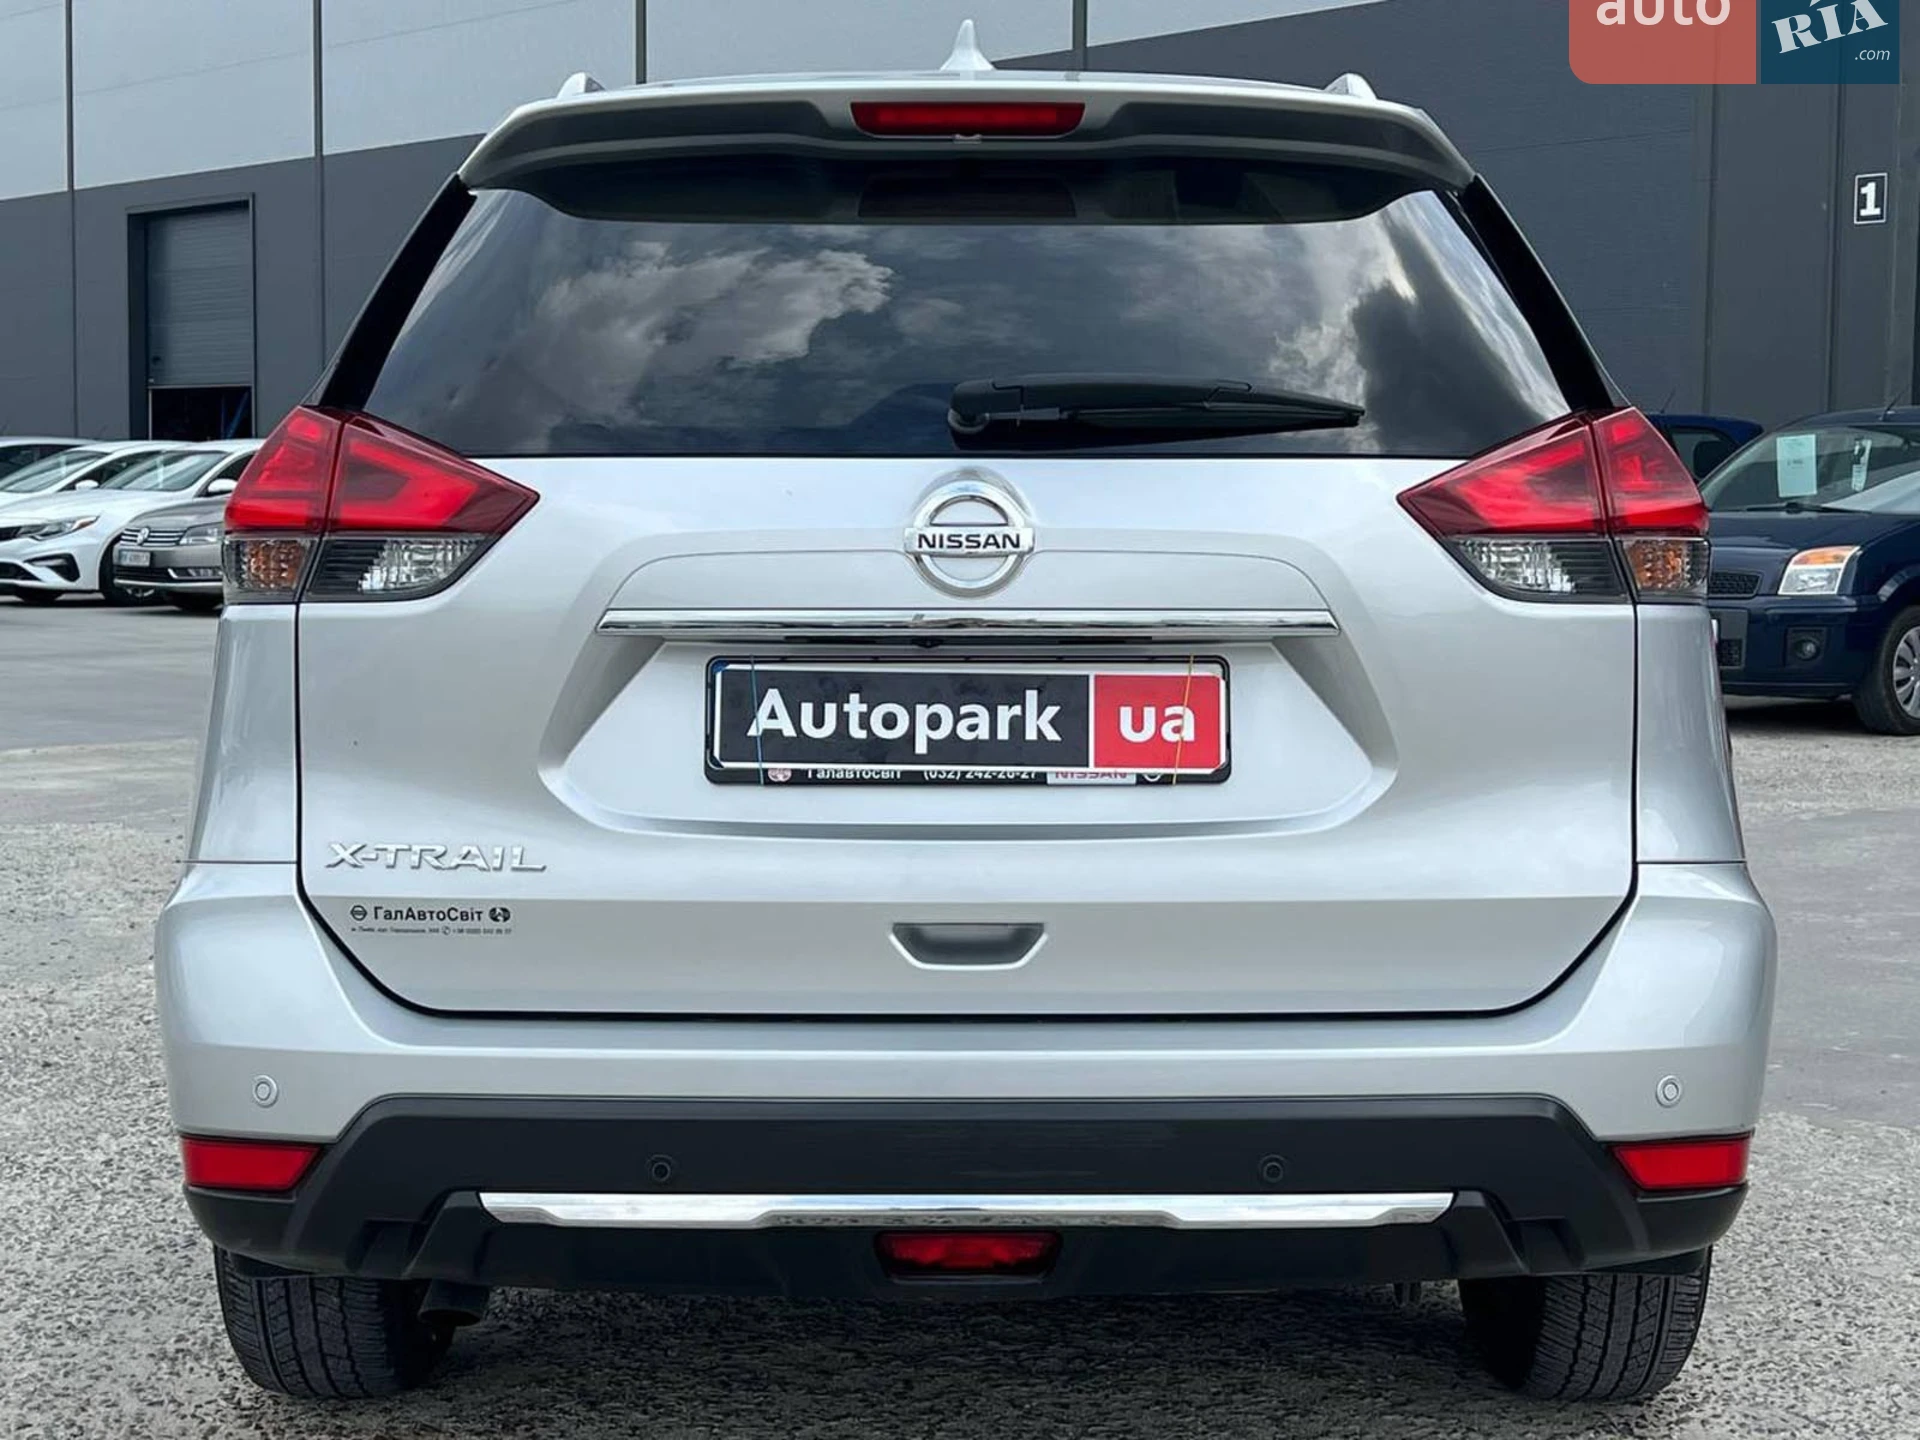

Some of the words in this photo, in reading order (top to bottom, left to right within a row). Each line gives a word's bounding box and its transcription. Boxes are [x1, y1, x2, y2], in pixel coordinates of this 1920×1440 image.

[1860, 181, 1881, 216] 1
[918, 533, 1020, 549] NISSAN
[747, 688, 1062, 754] Autopark
[1119, 703, 1196, 742] ua
[325, 842, 547, 872] X-TRAIL
[373, 906, 483, 922] ГалАвтоСвіт
